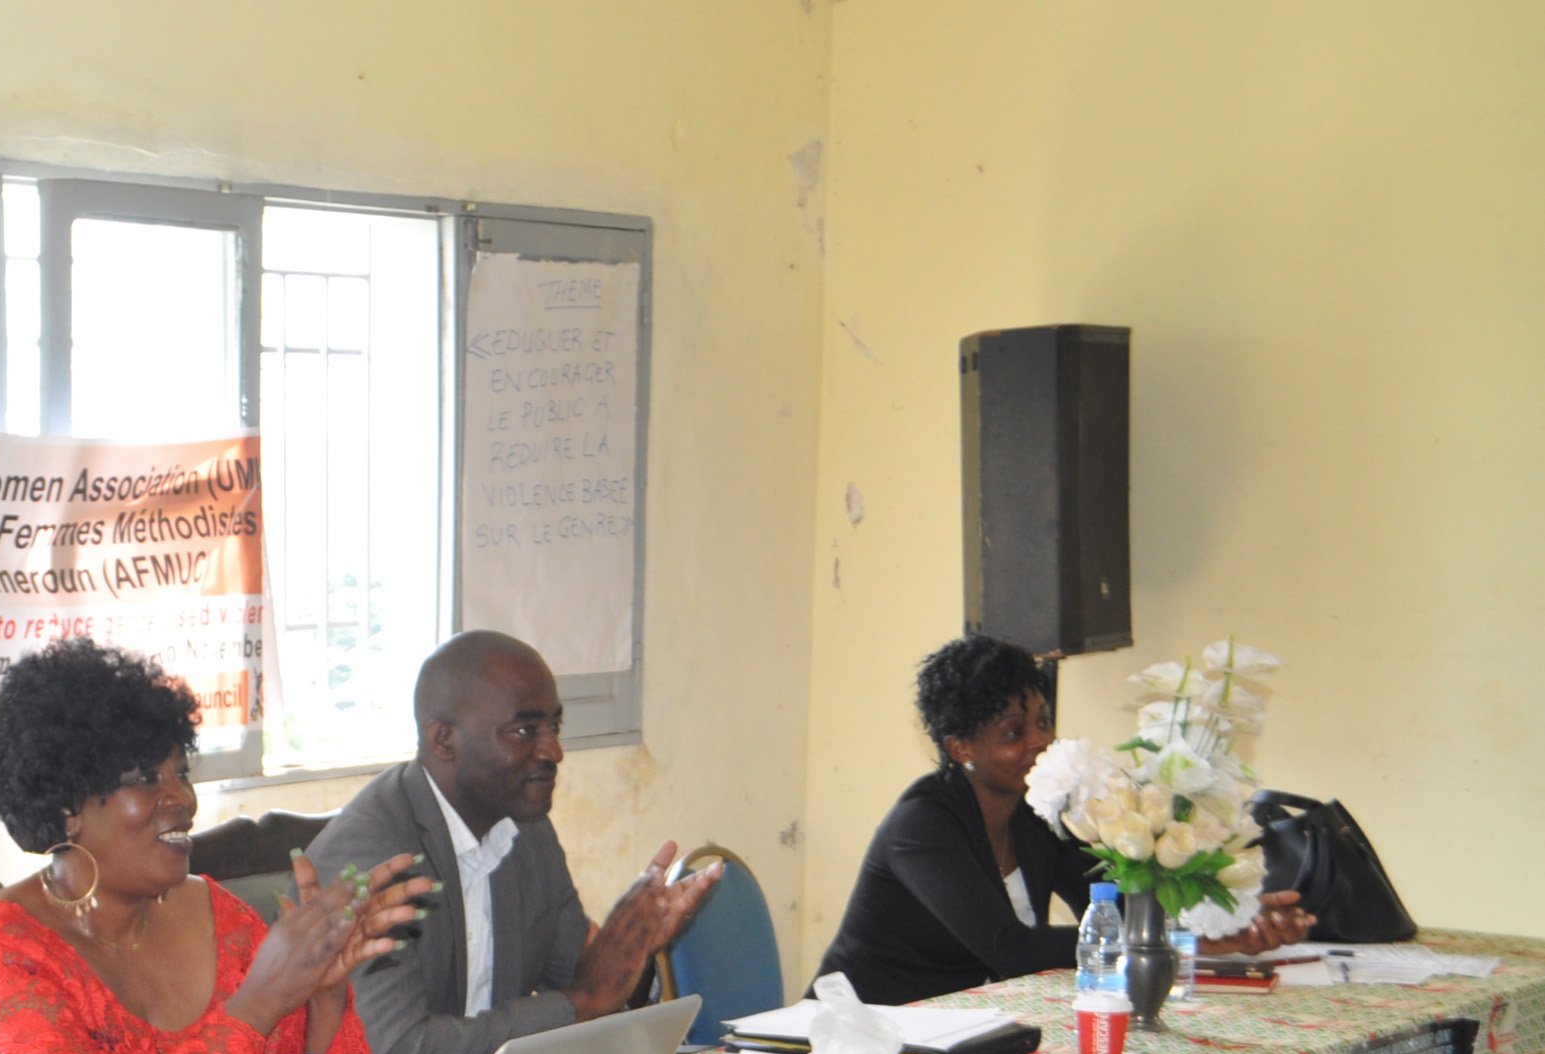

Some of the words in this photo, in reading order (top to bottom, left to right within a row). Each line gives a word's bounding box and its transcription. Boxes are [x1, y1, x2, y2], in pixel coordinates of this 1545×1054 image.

[593, 330, 616, 351] ET
[488, 407, 508, 430] LE
[521, 397, 583, 427] PUBLIC
[490, 437, 575, 472] REDUIRE
[584, 432, 610, 457] LA
[68, 465, 199, 502] Association
[207, 456, 260, 502] (UM
[481, 483, 575, 507] VIOLENCE
[112, 504, 258, 545] Méthodistes
[475, 524, 521, 547] SUR
[532, 524, 552, 544] LE
